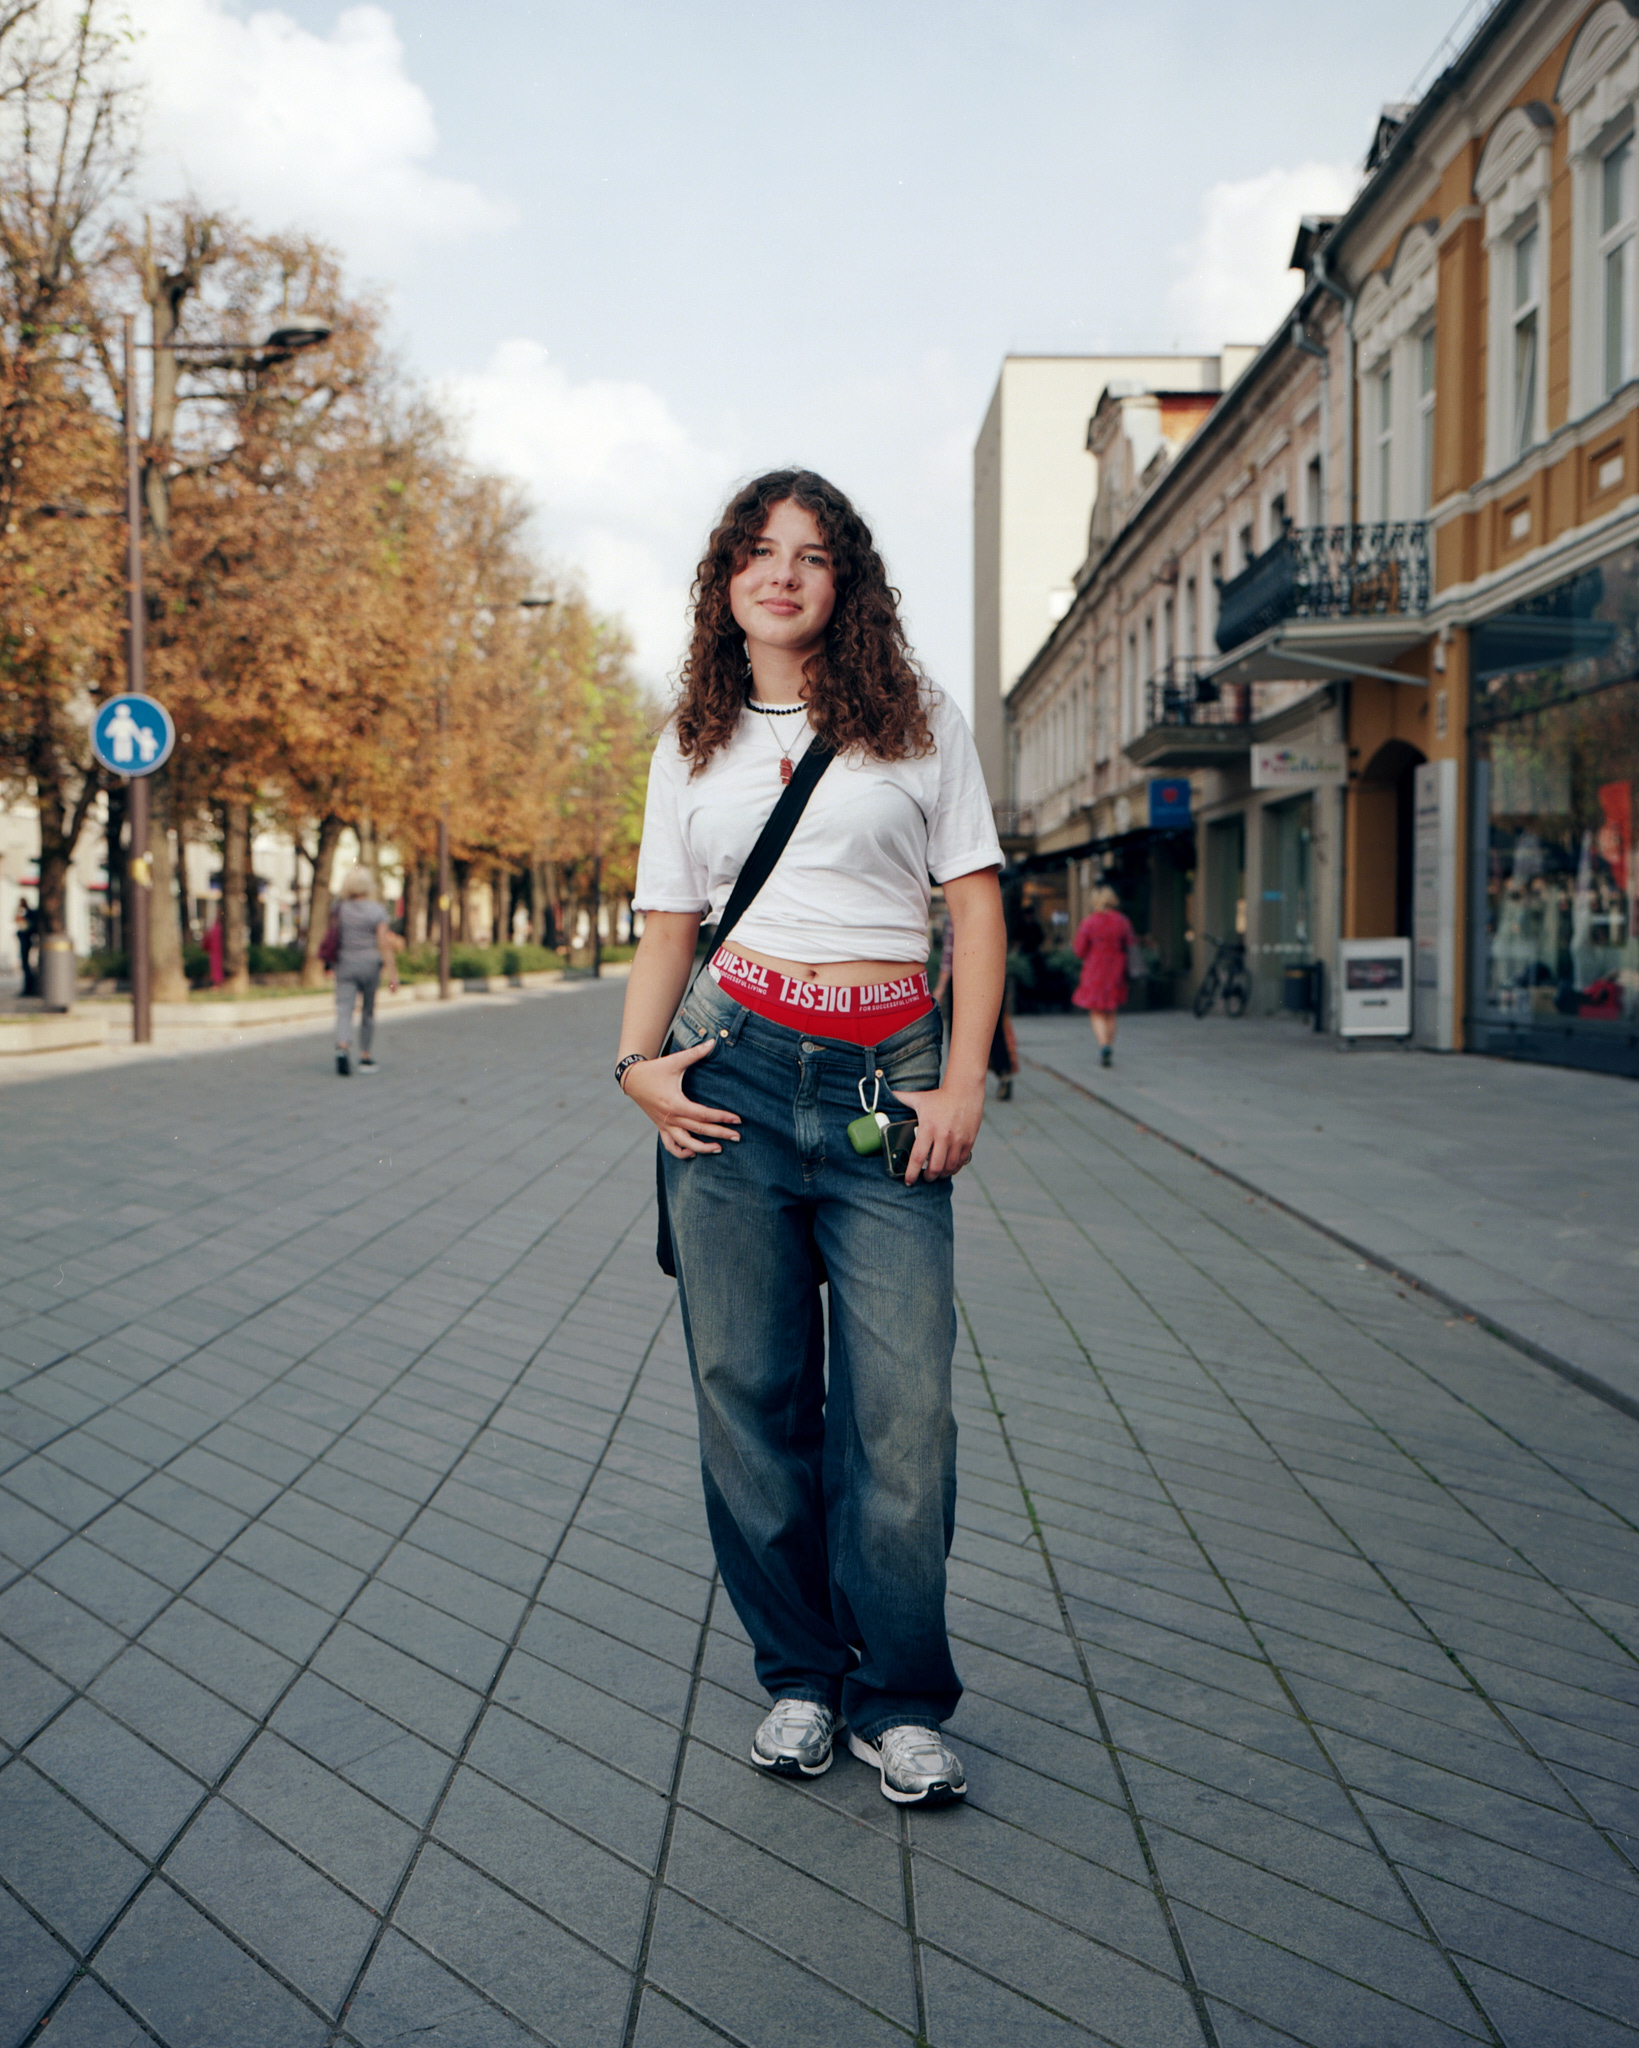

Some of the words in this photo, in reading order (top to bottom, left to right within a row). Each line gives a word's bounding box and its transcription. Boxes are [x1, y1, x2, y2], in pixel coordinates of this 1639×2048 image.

[715, 949, 769, 989] DIESEL
[747, 983, 767, 995] LIVING
[779, 974, 851, 1012] DIESEL
[859, 977, 918, 1005] DIESEL
[872, 1000, 905, 1011] SUCCESSFUL
[905, 995, 920, 1004] LIVING
